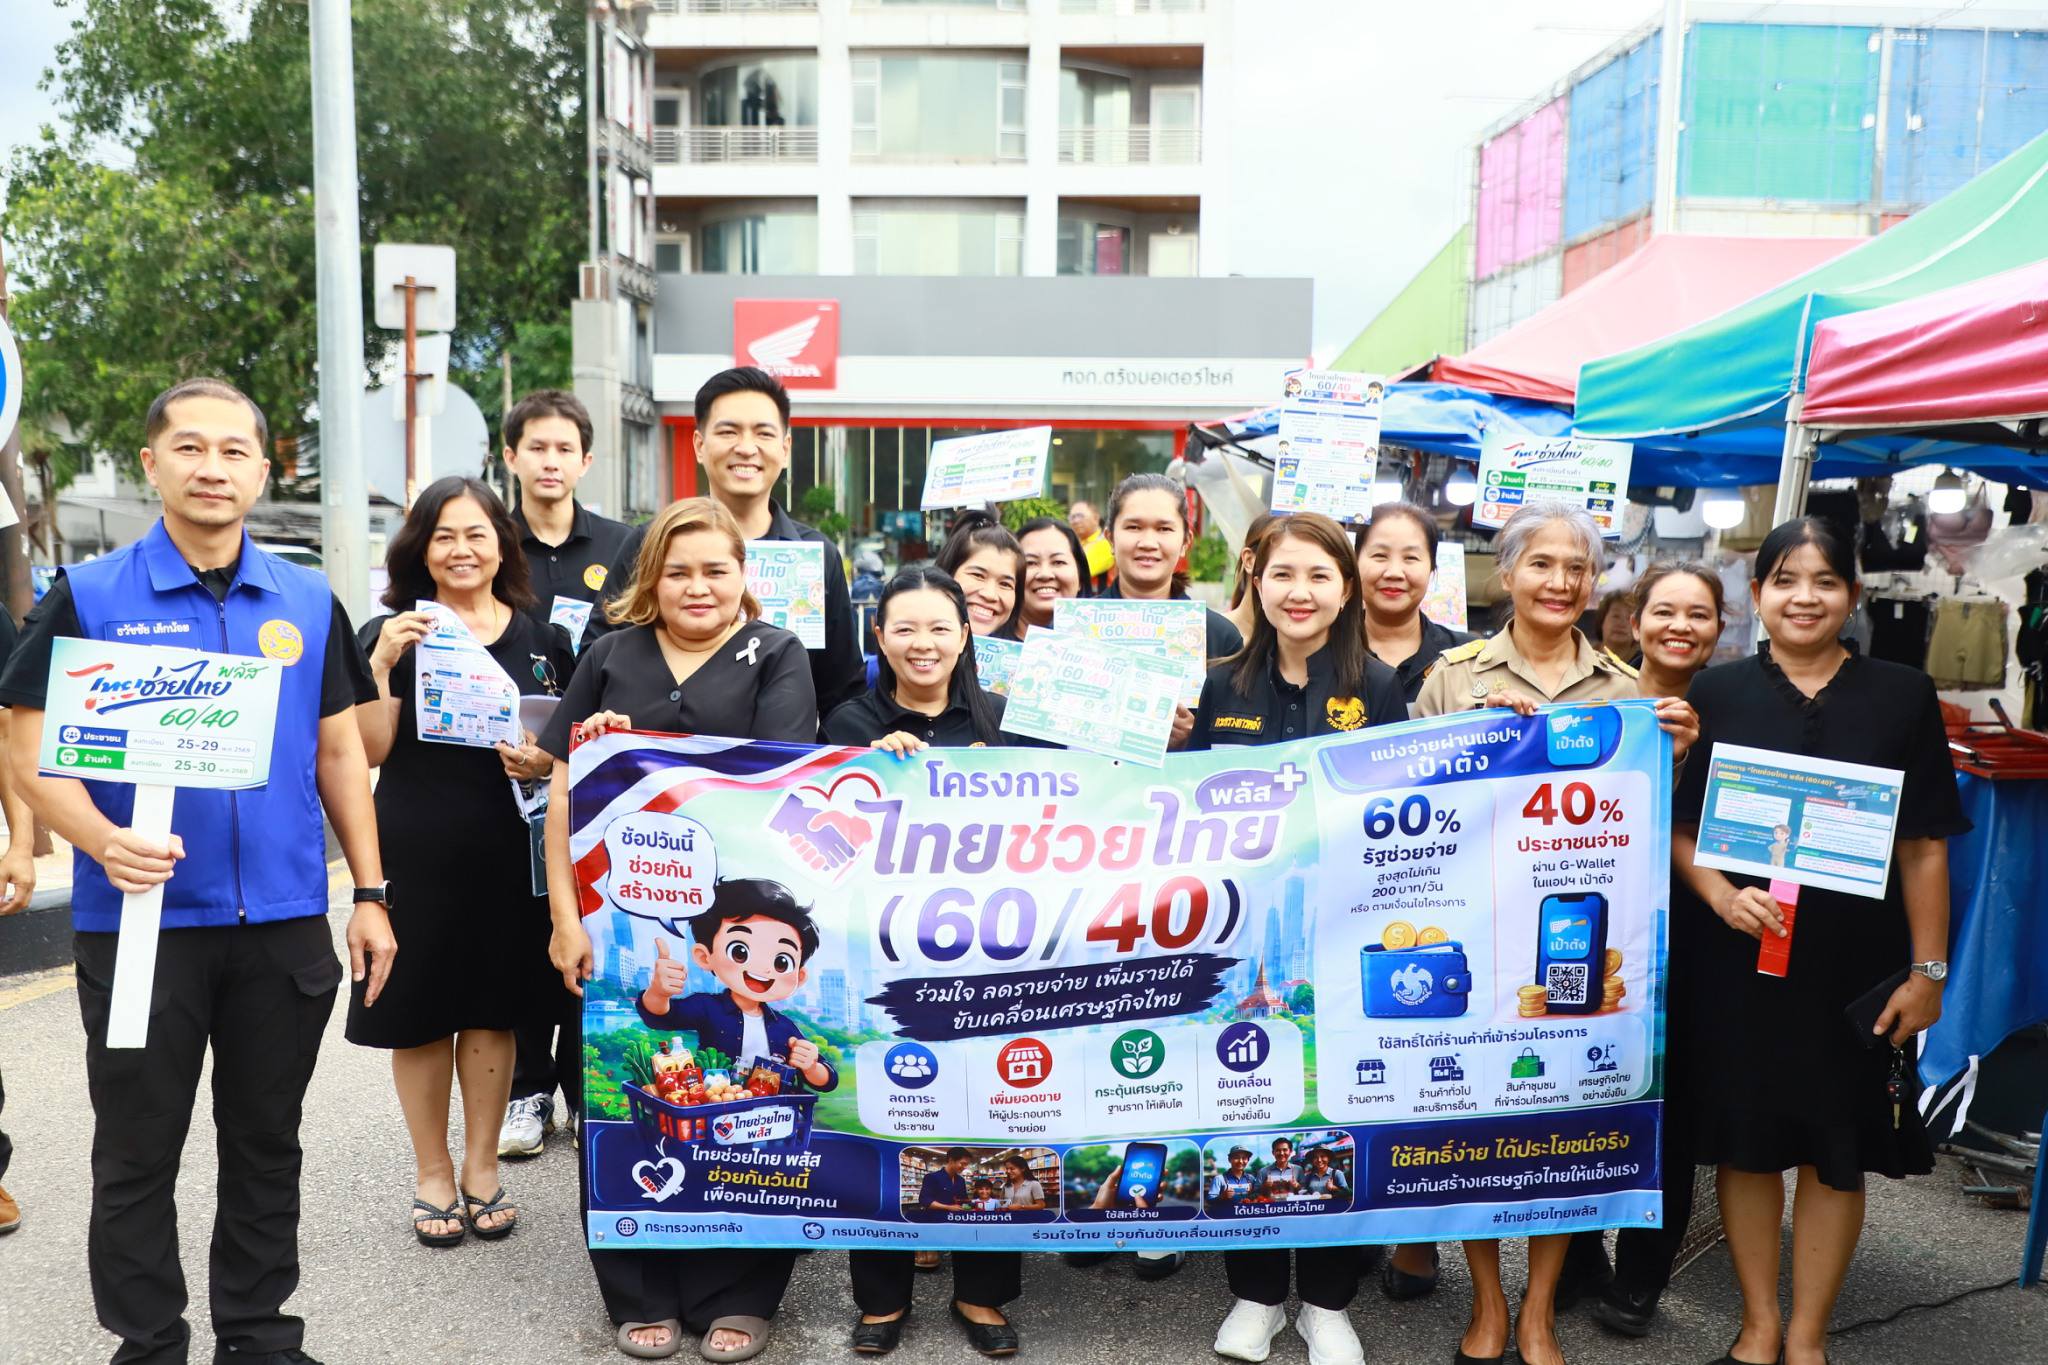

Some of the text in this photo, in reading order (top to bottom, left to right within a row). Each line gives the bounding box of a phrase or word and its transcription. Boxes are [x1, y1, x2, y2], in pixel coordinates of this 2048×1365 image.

[159, 704, 240, 731] 60/40
[176, 738, 219, 752] 25-29
[174, 759, 216, 773] 25-30
[926, 760, 1080, 799] โครงการ
[1522, 781, 1624, 827] 40%
[1363, 793, 1462, 840] 60%
[621, 826, 694, 852] ช้อปวันนี้
[853, 789, 1281, 875] ไทยช่วยไทย
[1517, 830, 1630, 852] ประชาชนจ่าย
[1363, 841, 1457, 867] รัฐช่วยจ่าย
[629, 855, 693, 879] ช่วยกัน
[1377, 865, 1441, 885] สูงสุดไม่เกิน
[1532, 858, 1616, 873] ผ่าน G-Wallet
[620, 879, 703, 905] สร้างชาติ
[1372, 886, 1396, 898] 200
[878, 875, 1241, 963] (60/40)
[915, 958, 1199, 1004] ร่วมใจ ลดรายจ่าย เพิ่มรายได้
[953, 988, 1183, 1031] ขับเคลื่อนเศรษฐกิจไทย
[1094, 1080, 1184, 1101] กระตุ้นเศรษฐกิจ
[1217, 1072, 1272, 1090] ขับเคลื่อน
[1506, 1081, 1556, 1094] สินค้าชุมชน
[889, 1093, 937, 1105] ลดภาระ
[989, 1090, 1062, 1106] เพิ่มยอดขาย
[1216, 1094, 1275, 1109] เศรษฐกิจไทย
[1347, 1092, 1395, 1105] ร้านอาหาร
[1418, 1086, 1471, 1100] ร้านค้าทั่วไป
[734, 1111, 792, 1130] ไทยช่วยไทย
[893, 1122, 935, 1132] ประชาชน
[1007, 1123, 1047, 1134] รายย่อย
[691, 1145, 782, 1166] ไทยช่วยไทย
[1390, 1130, 1630, 1168] ใช้สิทธิ์ง่าย ได้ประโยชน์จริง
[707, 1165, 812, 1190] ช่วยกันวันนี้
[1386, 1161, 1640, 1195] ร่วมกันสร้างเศรษฐกิจไทยให้แข็งแรง
[704, 1183, 838, 1210] เพื่อคนไทยทุกคน
[644, 1221, 744, 1234] กระทรวงการคลัง
[831, 1226, 920, 1240] กรมบัญชีกลาง
[1032, 1228, 1101, 1241] ร่วมใจไทย
